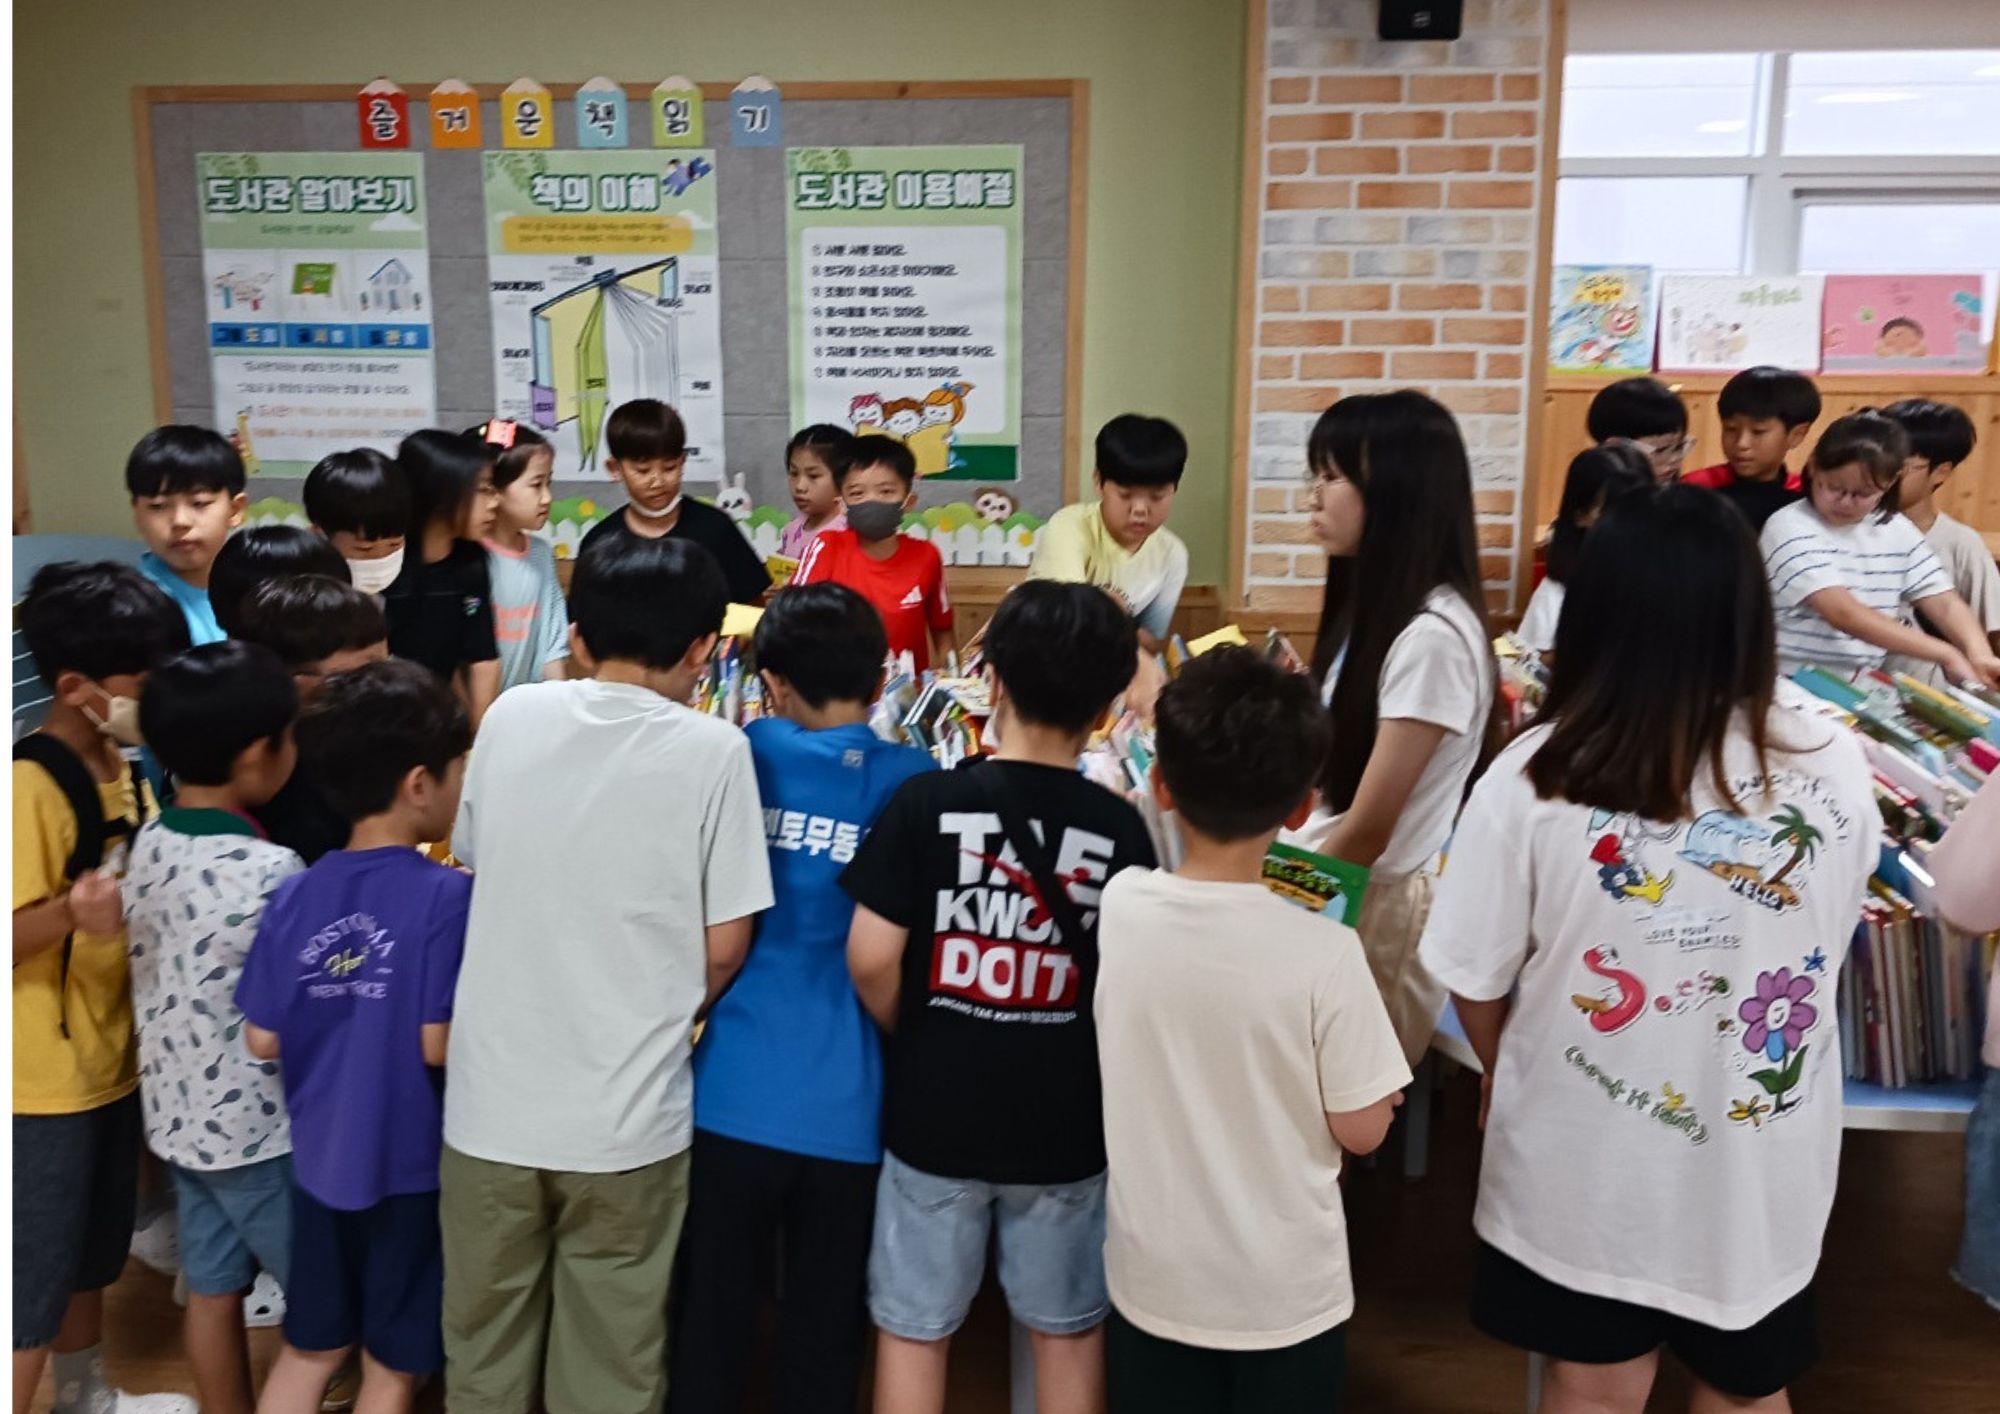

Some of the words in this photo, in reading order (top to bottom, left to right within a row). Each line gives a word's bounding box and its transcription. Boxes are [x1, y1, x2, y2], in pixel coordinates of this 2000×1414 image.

[206, 176, 293, 213] 도서관
[298, 176, 416, 213] 알아보기
[530, 172, 592, 211] 책의
[597, 172, 660, 211] 이해
[795, 170, 888, 209] 도서관
[893, 169, 1015, 208] 이용예절
[1729, 873, 1785, 911] HELLO
